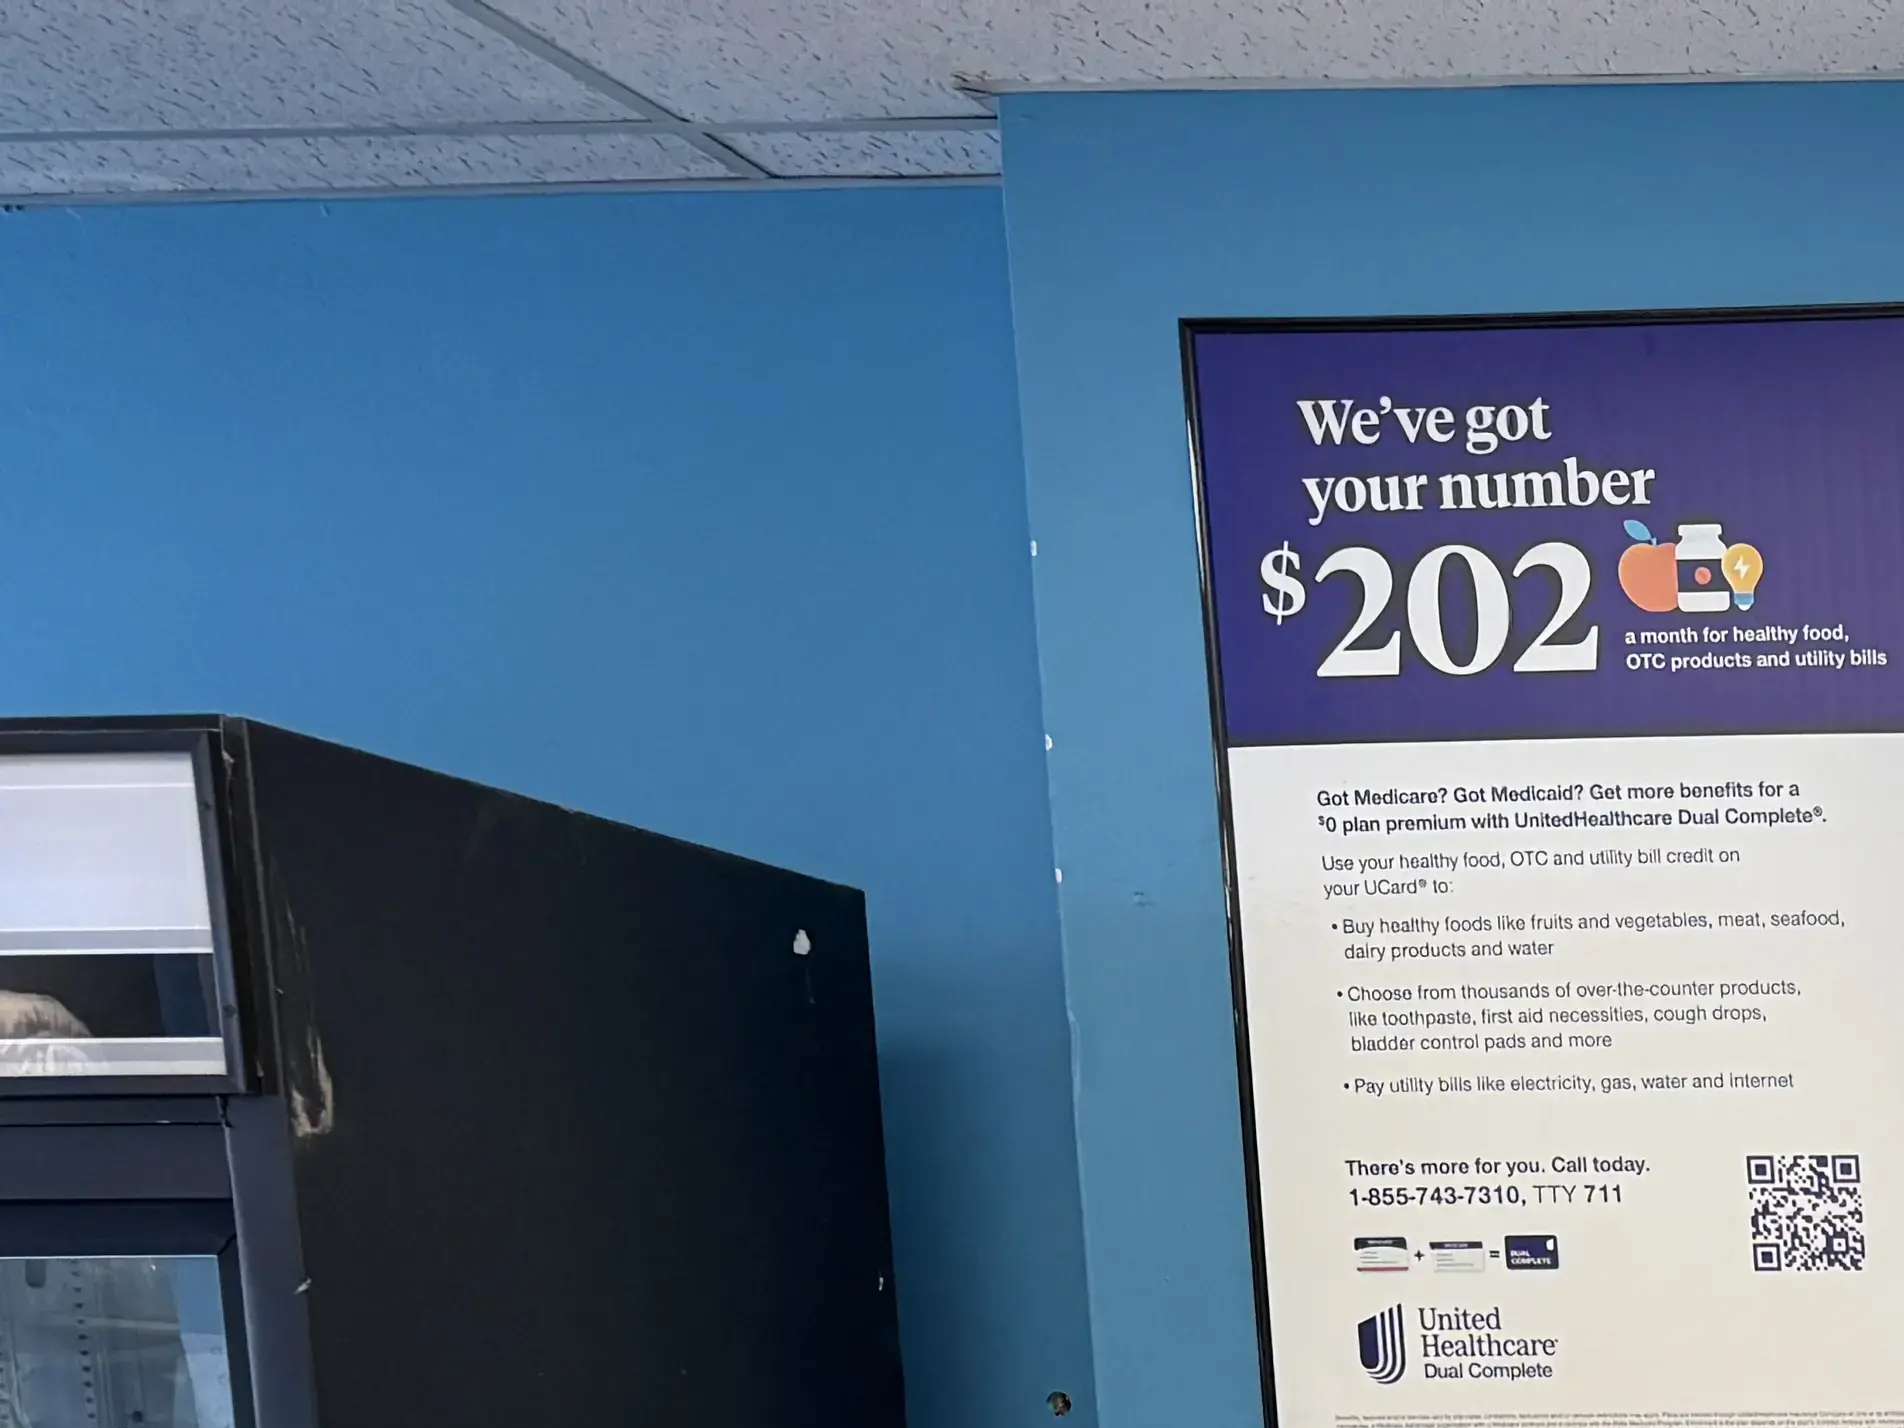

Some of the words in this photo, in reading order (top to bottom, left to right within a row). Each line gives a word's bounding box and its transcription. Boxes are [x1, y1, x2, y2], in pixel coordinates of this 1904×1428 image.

[1297, 396, 1455, 447] We've
[1465, 396, 1553, 454] got
[1302, 474, 1428, 525] your
[1439, 457, 1655, 510] number
[1261, 541, 1598, 676] $202
[1625, 632, 1636, 644] a
[1640, 627, 1698, 644] month
[1703, 626, 1729, 643] for
[1733, 625, 1799, 645] healthy
[1803, 623, 1850, 643] food,
[1626, 653, 1666, 670] OTC
[1670, 652, 1752, 673] products
[1757, 651, 1790, 667] and
[1795, 649, 1846, 670] utility
[1850, 648, 1888, 666] bills
[1317, 790, 1350, 807] Got
[1353, 787, 1449, 806] Medicare?
[1453, 786, 1487, 804] Got
[1491, 783, 1584, 803] Medicaid?
[1589, 783, 1623, 801] Get
[1627, 785, 1674, 800] more
[1679, 781, 1753, 799] benefits
[1757, 781, 1785, 797] for
[1789, 785, 1801, 797] a
[1344, 1158, 1416, 1177] There's
[1420, 1161, 1469, 1175] more
[1474, 1158, 1501, 1174] for
[1505, 1160, 1546, 1178] you.
[1551, 1155, 1587, 1173] Call
[1592, 1155, 1651, 1176] today.
[1349, 1185, 1528, 1207] 1-855-743-7310,
[1533, 1185, 1577, 1204] TTY
[1583, 1183, 1622, 1203] 711
[1418, 1306, 1502, 1330] United
[1421, 1333, 1558, 1358] Healthcare
[1424, 1363, 1464, 1379] Dual
[1468, 1361, 1553, 1381] Complete
